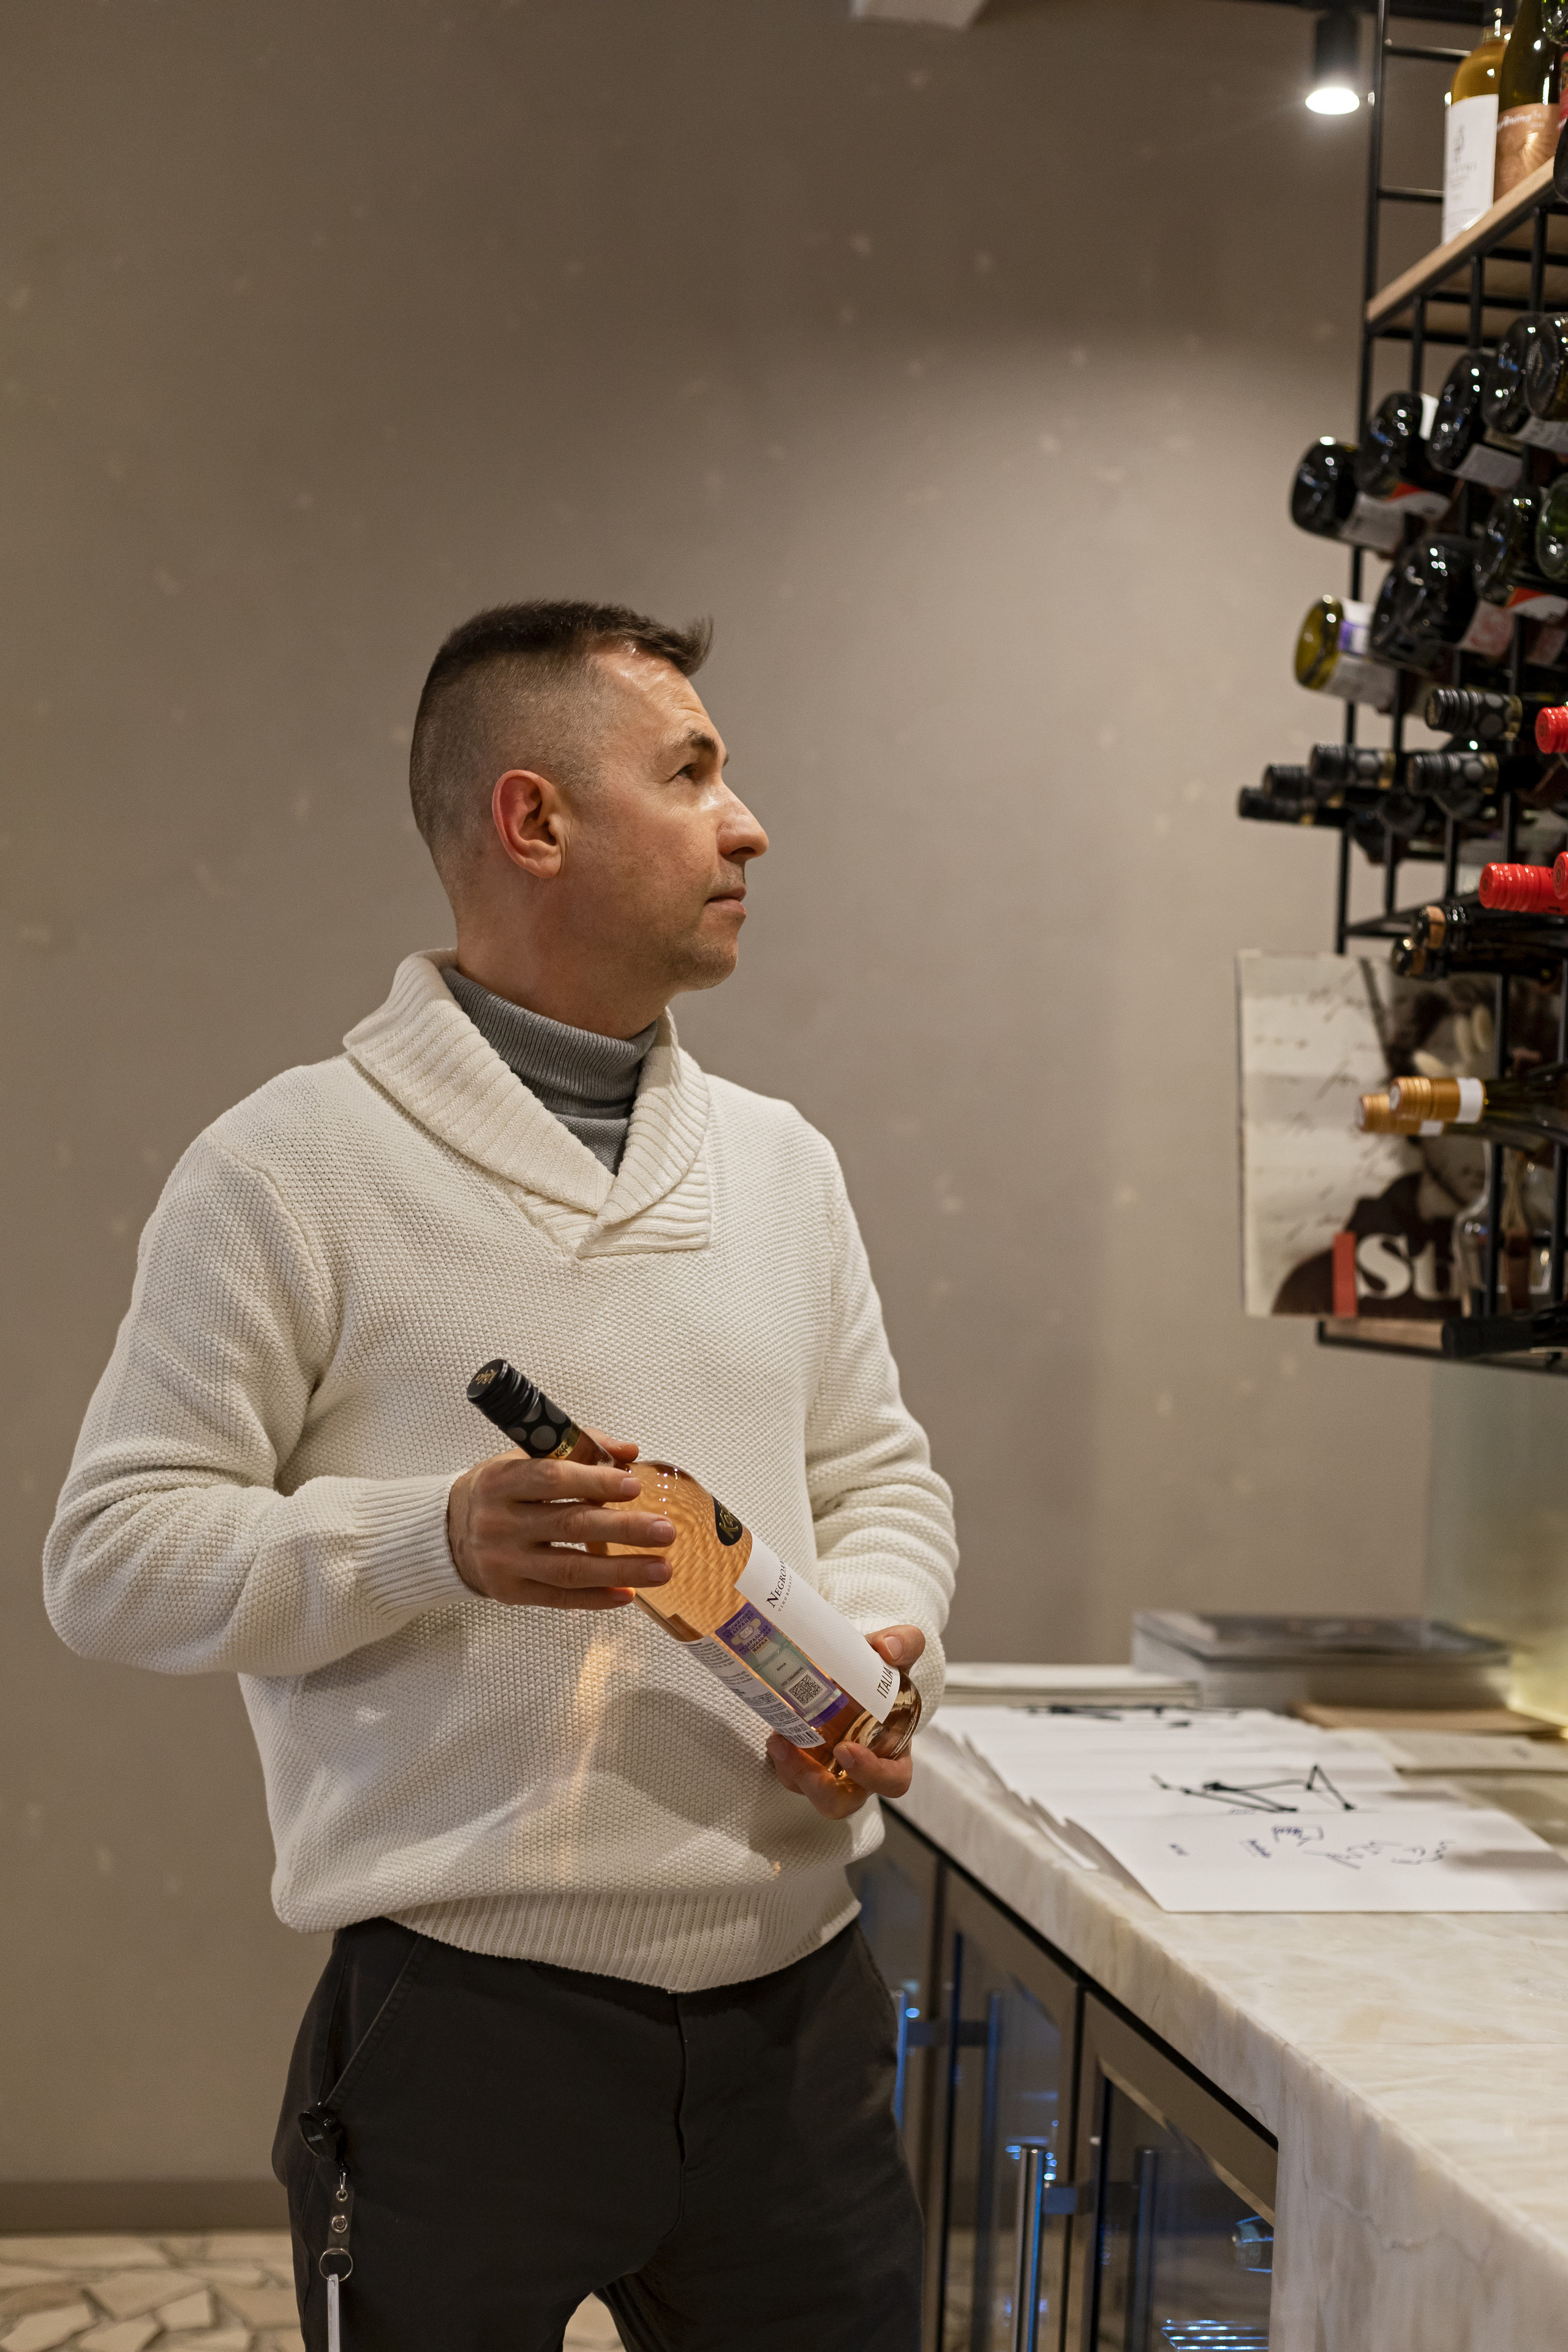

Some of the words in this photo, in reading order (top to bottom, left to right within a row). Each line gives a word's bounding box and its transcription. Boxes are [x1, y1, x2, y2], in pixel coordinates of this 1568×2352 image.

[723, 1610, 752, 1636] РОССИЙСКАЯ
[726, 1613, 754, 1638] ФЕДЕРАЦИЯ
[739, 1625, 768, 1652] ФЕДЕРАЛЬНАЯ
[742, 1628, 772, 1655] СПЕЦИАЛЬНАЯ
[752, 1638, 768, 1653] МАРКА
[877, 1666, 894, 1699] ITALIA
